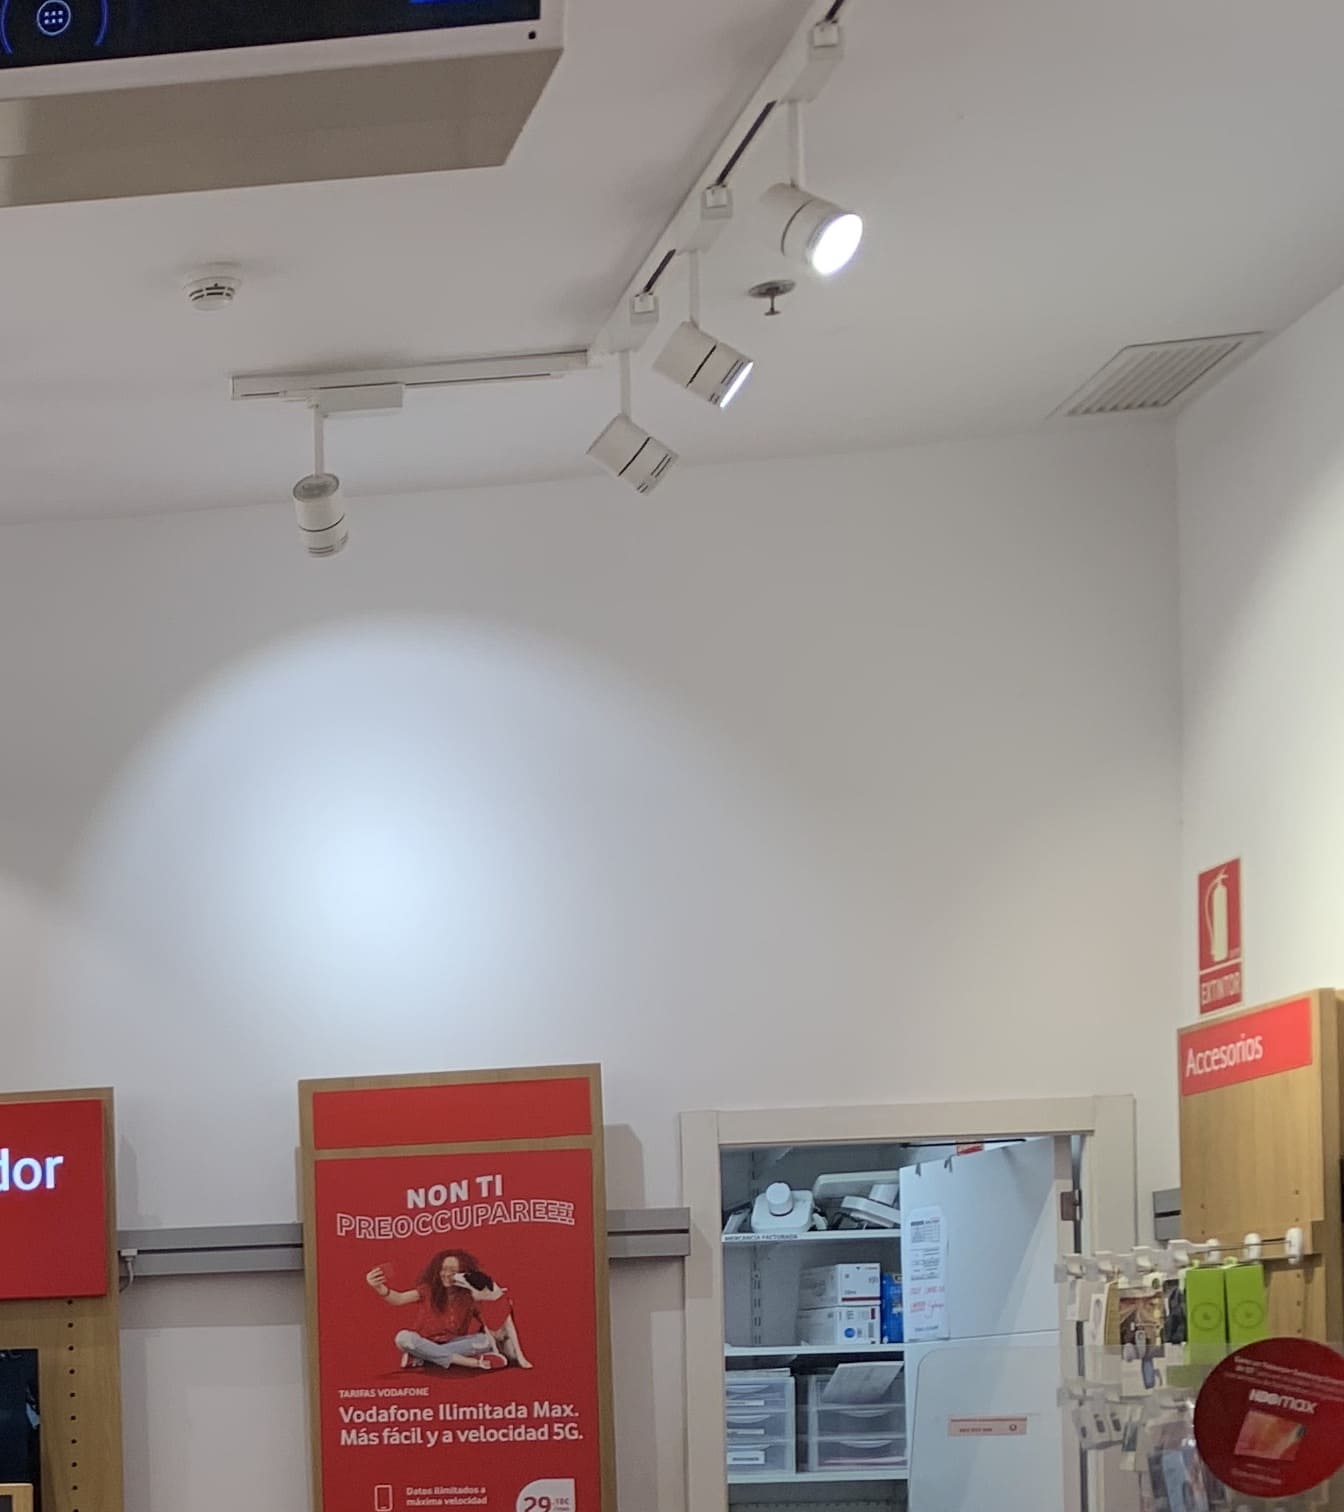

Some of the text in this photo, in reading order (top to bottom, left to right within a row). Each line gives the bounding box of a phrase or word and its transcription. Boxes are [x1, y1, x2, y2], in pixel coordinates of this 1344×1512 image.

[1186, 1033, 1263, 1078] Accesorios
[407, 1174, 502, 1209] NON TI
[339, 1387, 429, 1399] TARIFAS VODAFONE
[339, 1401, 579, 1423] Vodafone Ilimitada Max.
[340, 1423, 583, 1447] Más fácil y a velocidad 5G.
[406, 1487, 433, 1496] Datos
[443, 1496, 487, 1505] velocidad
